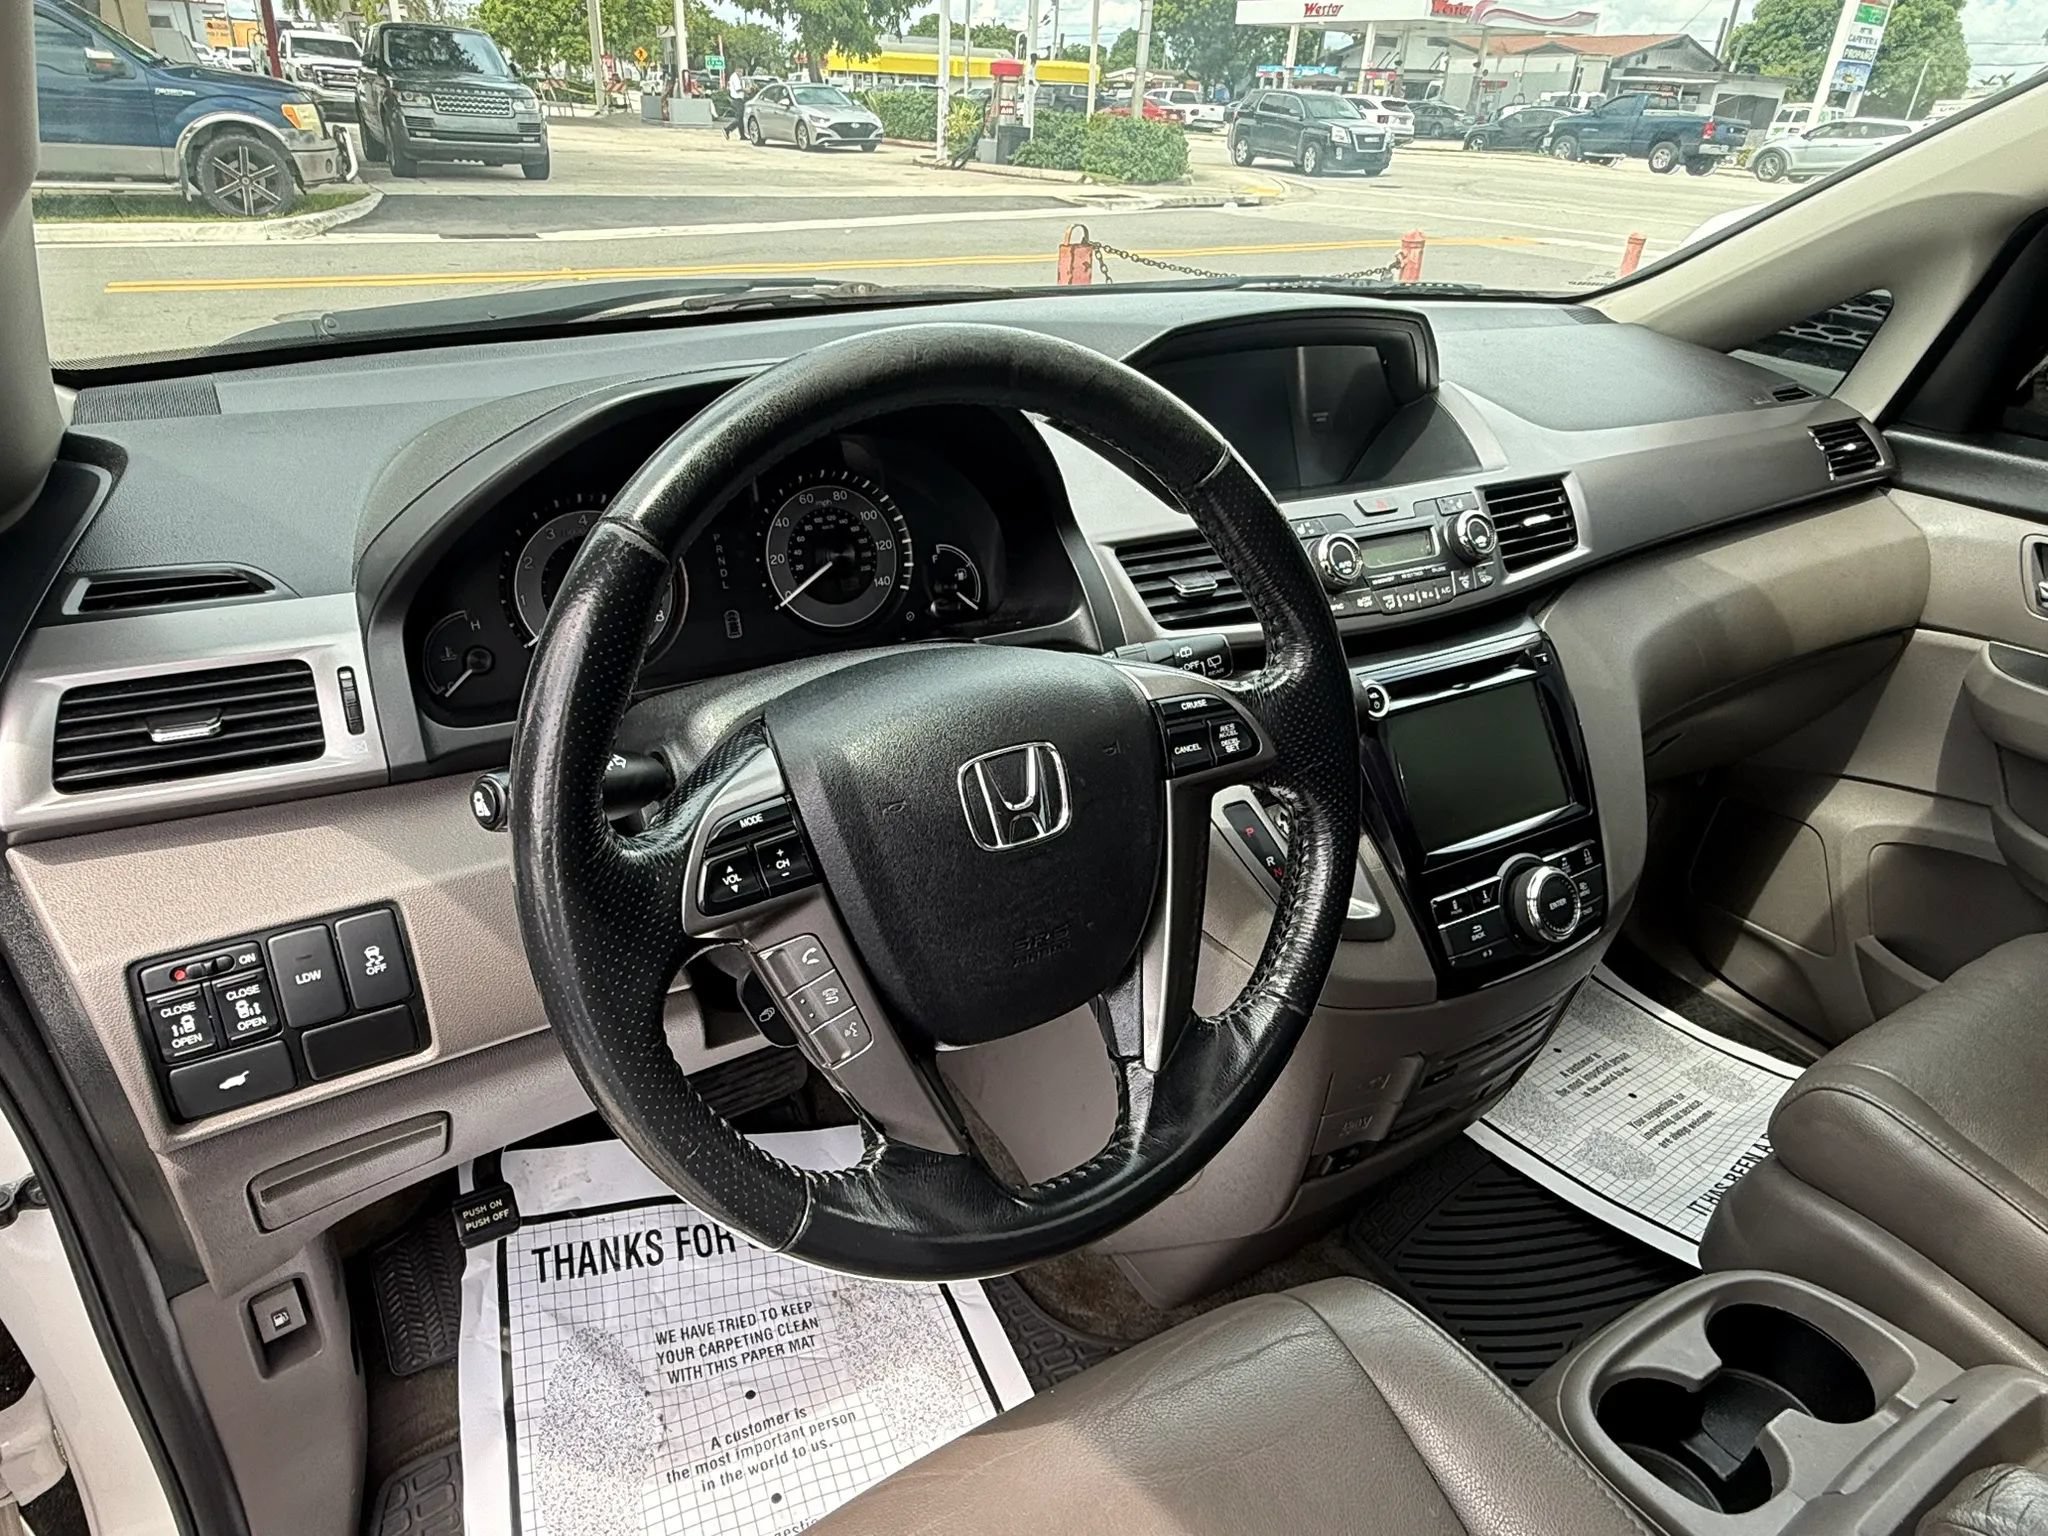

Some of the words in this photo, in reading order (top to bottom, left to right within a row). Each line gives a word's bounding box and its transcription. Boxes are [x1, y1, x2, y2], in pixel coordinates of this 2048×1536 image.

[799, 493, 814, 504] 60
[832, 490, 848, 501] 80
[578, 514, 588, 526] 4
[860, 510, 878, 521] 100
[775, 517, 790, 528] 40
[545, 528, 556, 540] 3
[876, 540, 892, 551] 120
[522, 556, 534, 570] 2
[770, 554, 785, 565] 20
[874, 576, 891, 588] 140
[470, 620, 481, 632] H
[1184, 660, 1200, 670] OFF
[1180, 698, 1208, 710] CRUISE
[1174, 742, 1202, 754] CANCEL
[739, 812, 764, 828] MODE
[1245, 826, 1255, 838] P
[776, 858, 790, 870] CH
[1266, 856, 1276, 867] R
[722, 873, 743, 886] VOL
[238, 952, 256, 965] ON
[366, 961, 388, 976] OFF
[295, 968, 322, 986] LDW
[226, 984, 260, 1002] CLOSE
[160, 1001, 197, 1018] CLOSE
[237, 1015, 267, 1031] OPEN
[172, 1032, 203, 1048] OPEN
[462, 1204, 488, 1219] PUSH
[489, 1198, 502, 1209] ON
[1686, 1200, 1712, 1216] IT
[465, 1216, 490, 1231] PUSH
[492, 1208, 510, 1221] OFF
[531, 1228, 665, 1284] THANKS
[676, 1223, 736, 1262] FOR
[655, 1329, 676, 1346] WE
[680, 1322, 715, 1342] HAVE
[718, 1313, 757, 1333] TRIED
[760, 1308, 778, 1322] TO
[782, 1301, 813, 1317] KEEP
[656, 1346, 695, 1366] YOUR
[700, 1328, 774, 1358] CARPETING
[778, 1317, 819, 1337] CLEAN
[667, 1366, 703, 1384] WITH
[706, 1356, 738, 1376] THIS
[742, 1344, 786, 1364] PAPER
[788, 1334, 816, 1354] MAT
[710, 1436, 722, 1451] A
[725, 1411, 790, 1446] customer
[794, 1407, 808, 1420] is
[666, 1468, 690, 1484] the
[695, 1451, 732, 1476] most
[735, 1426, 806, 1461] important
[808, 1411, 857, 1437] person
[702, 1479, 716, 1492] in
[720, 1469, 744, 1487] the
[747, 1450, 789, 1476] world
[792, 1445, 807, 1460] to
[810, 1438, 834, 1452] us.
